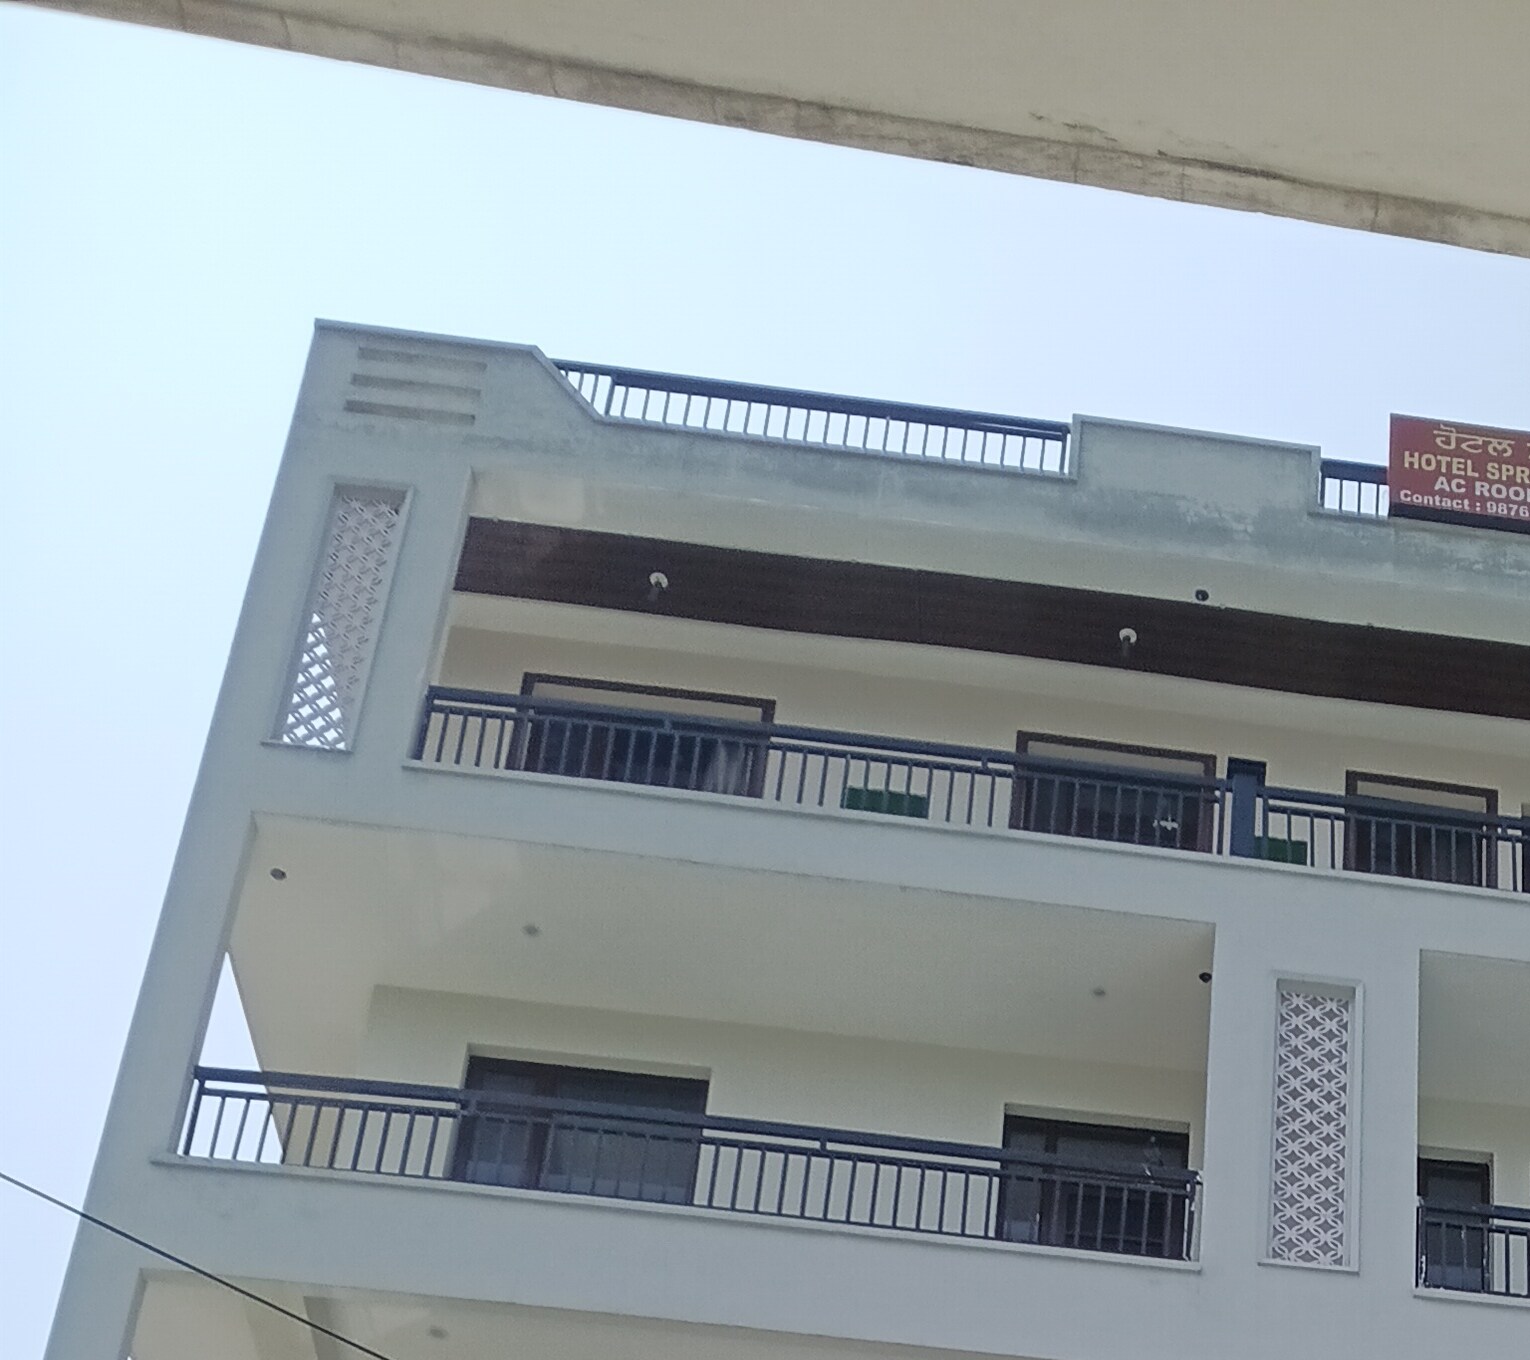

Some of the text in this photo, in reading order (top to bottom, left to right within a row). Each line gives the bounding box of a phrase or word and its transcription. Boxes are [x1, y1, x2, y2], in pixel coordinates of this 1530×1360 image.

[1433, 423, 1515, 457] ਹੋਟਲ
[1404, 451, 1479, 478] HOTEL
[1434, 476, 1466, 493] AC
[1400, 490, 1470, 510] Contact
